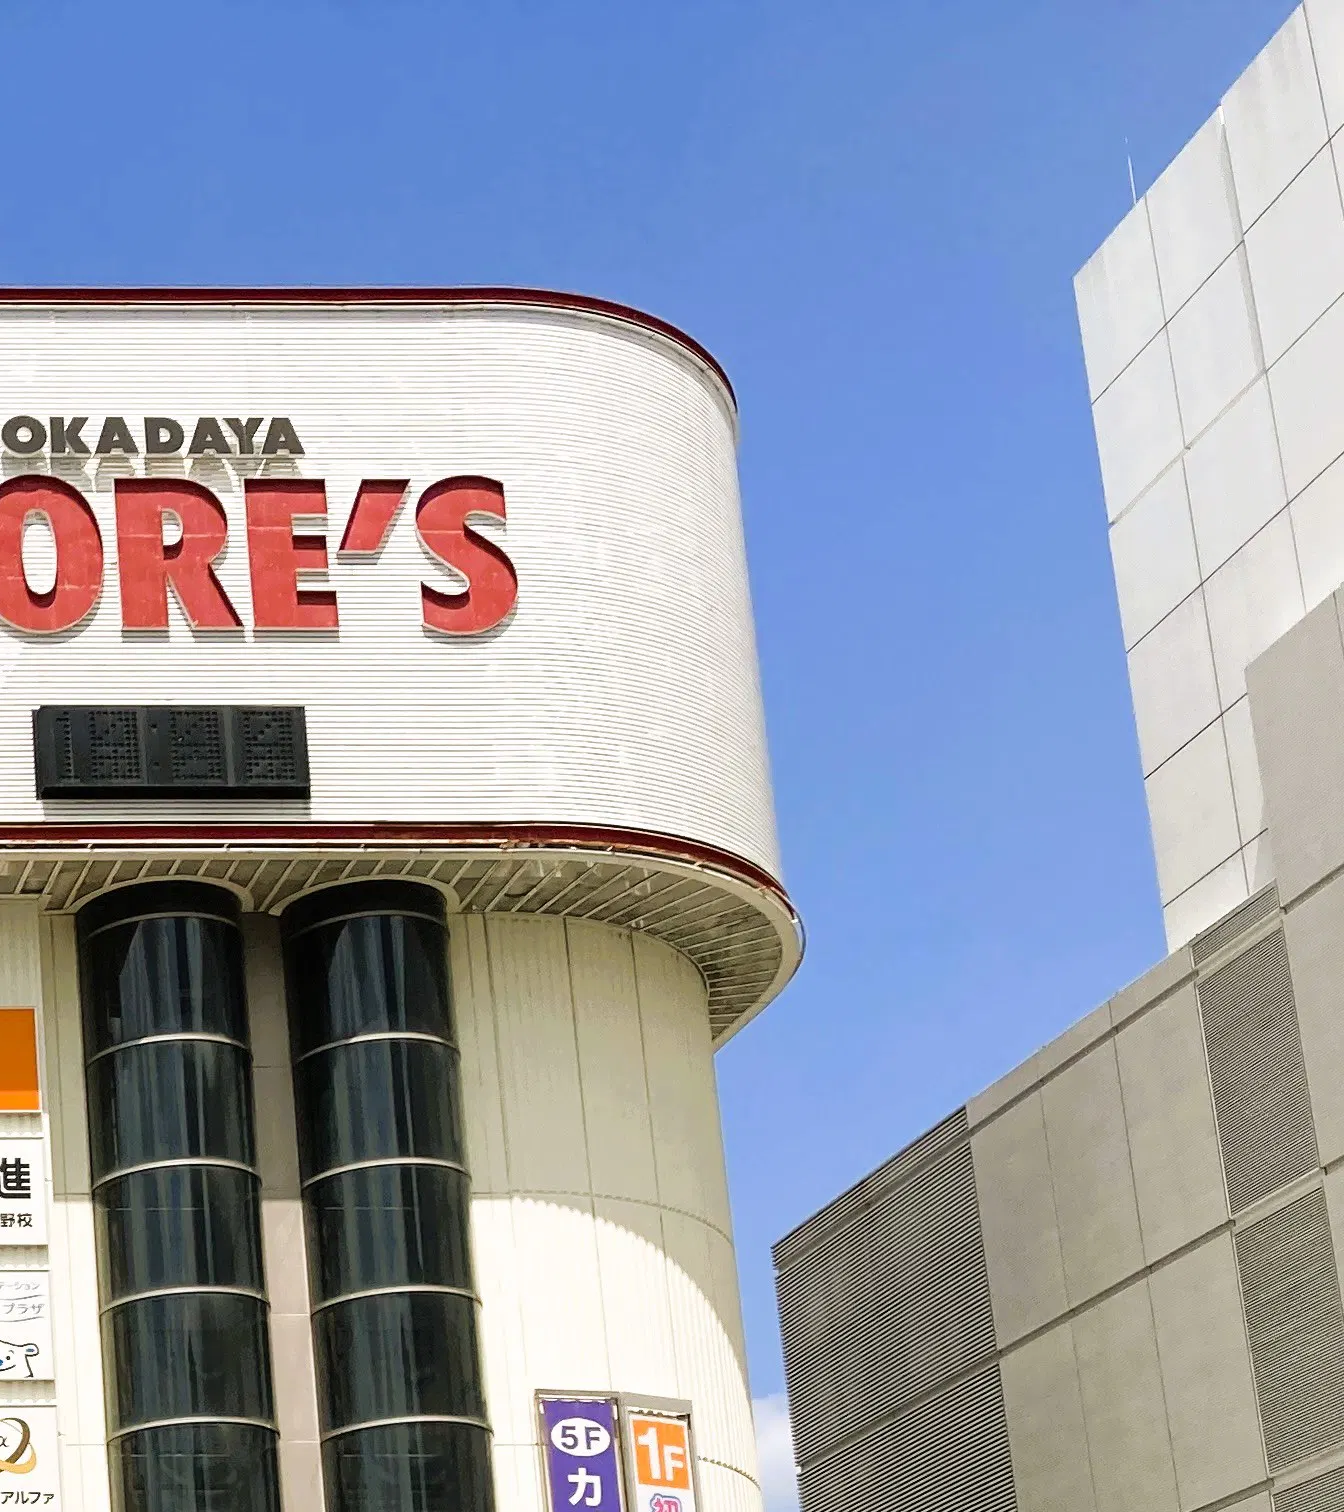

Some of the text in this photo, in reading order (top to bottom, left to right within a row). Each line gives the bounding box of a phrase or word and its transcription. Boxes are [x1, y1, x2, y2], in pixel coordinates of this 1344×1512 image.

[1, 415, 305, 456] OKADAYA
[559, 1425, 603, 1451] 5F
[636, 1424, 687, 1482] 1F
[0, 1491, 56, 1506] アルファ
